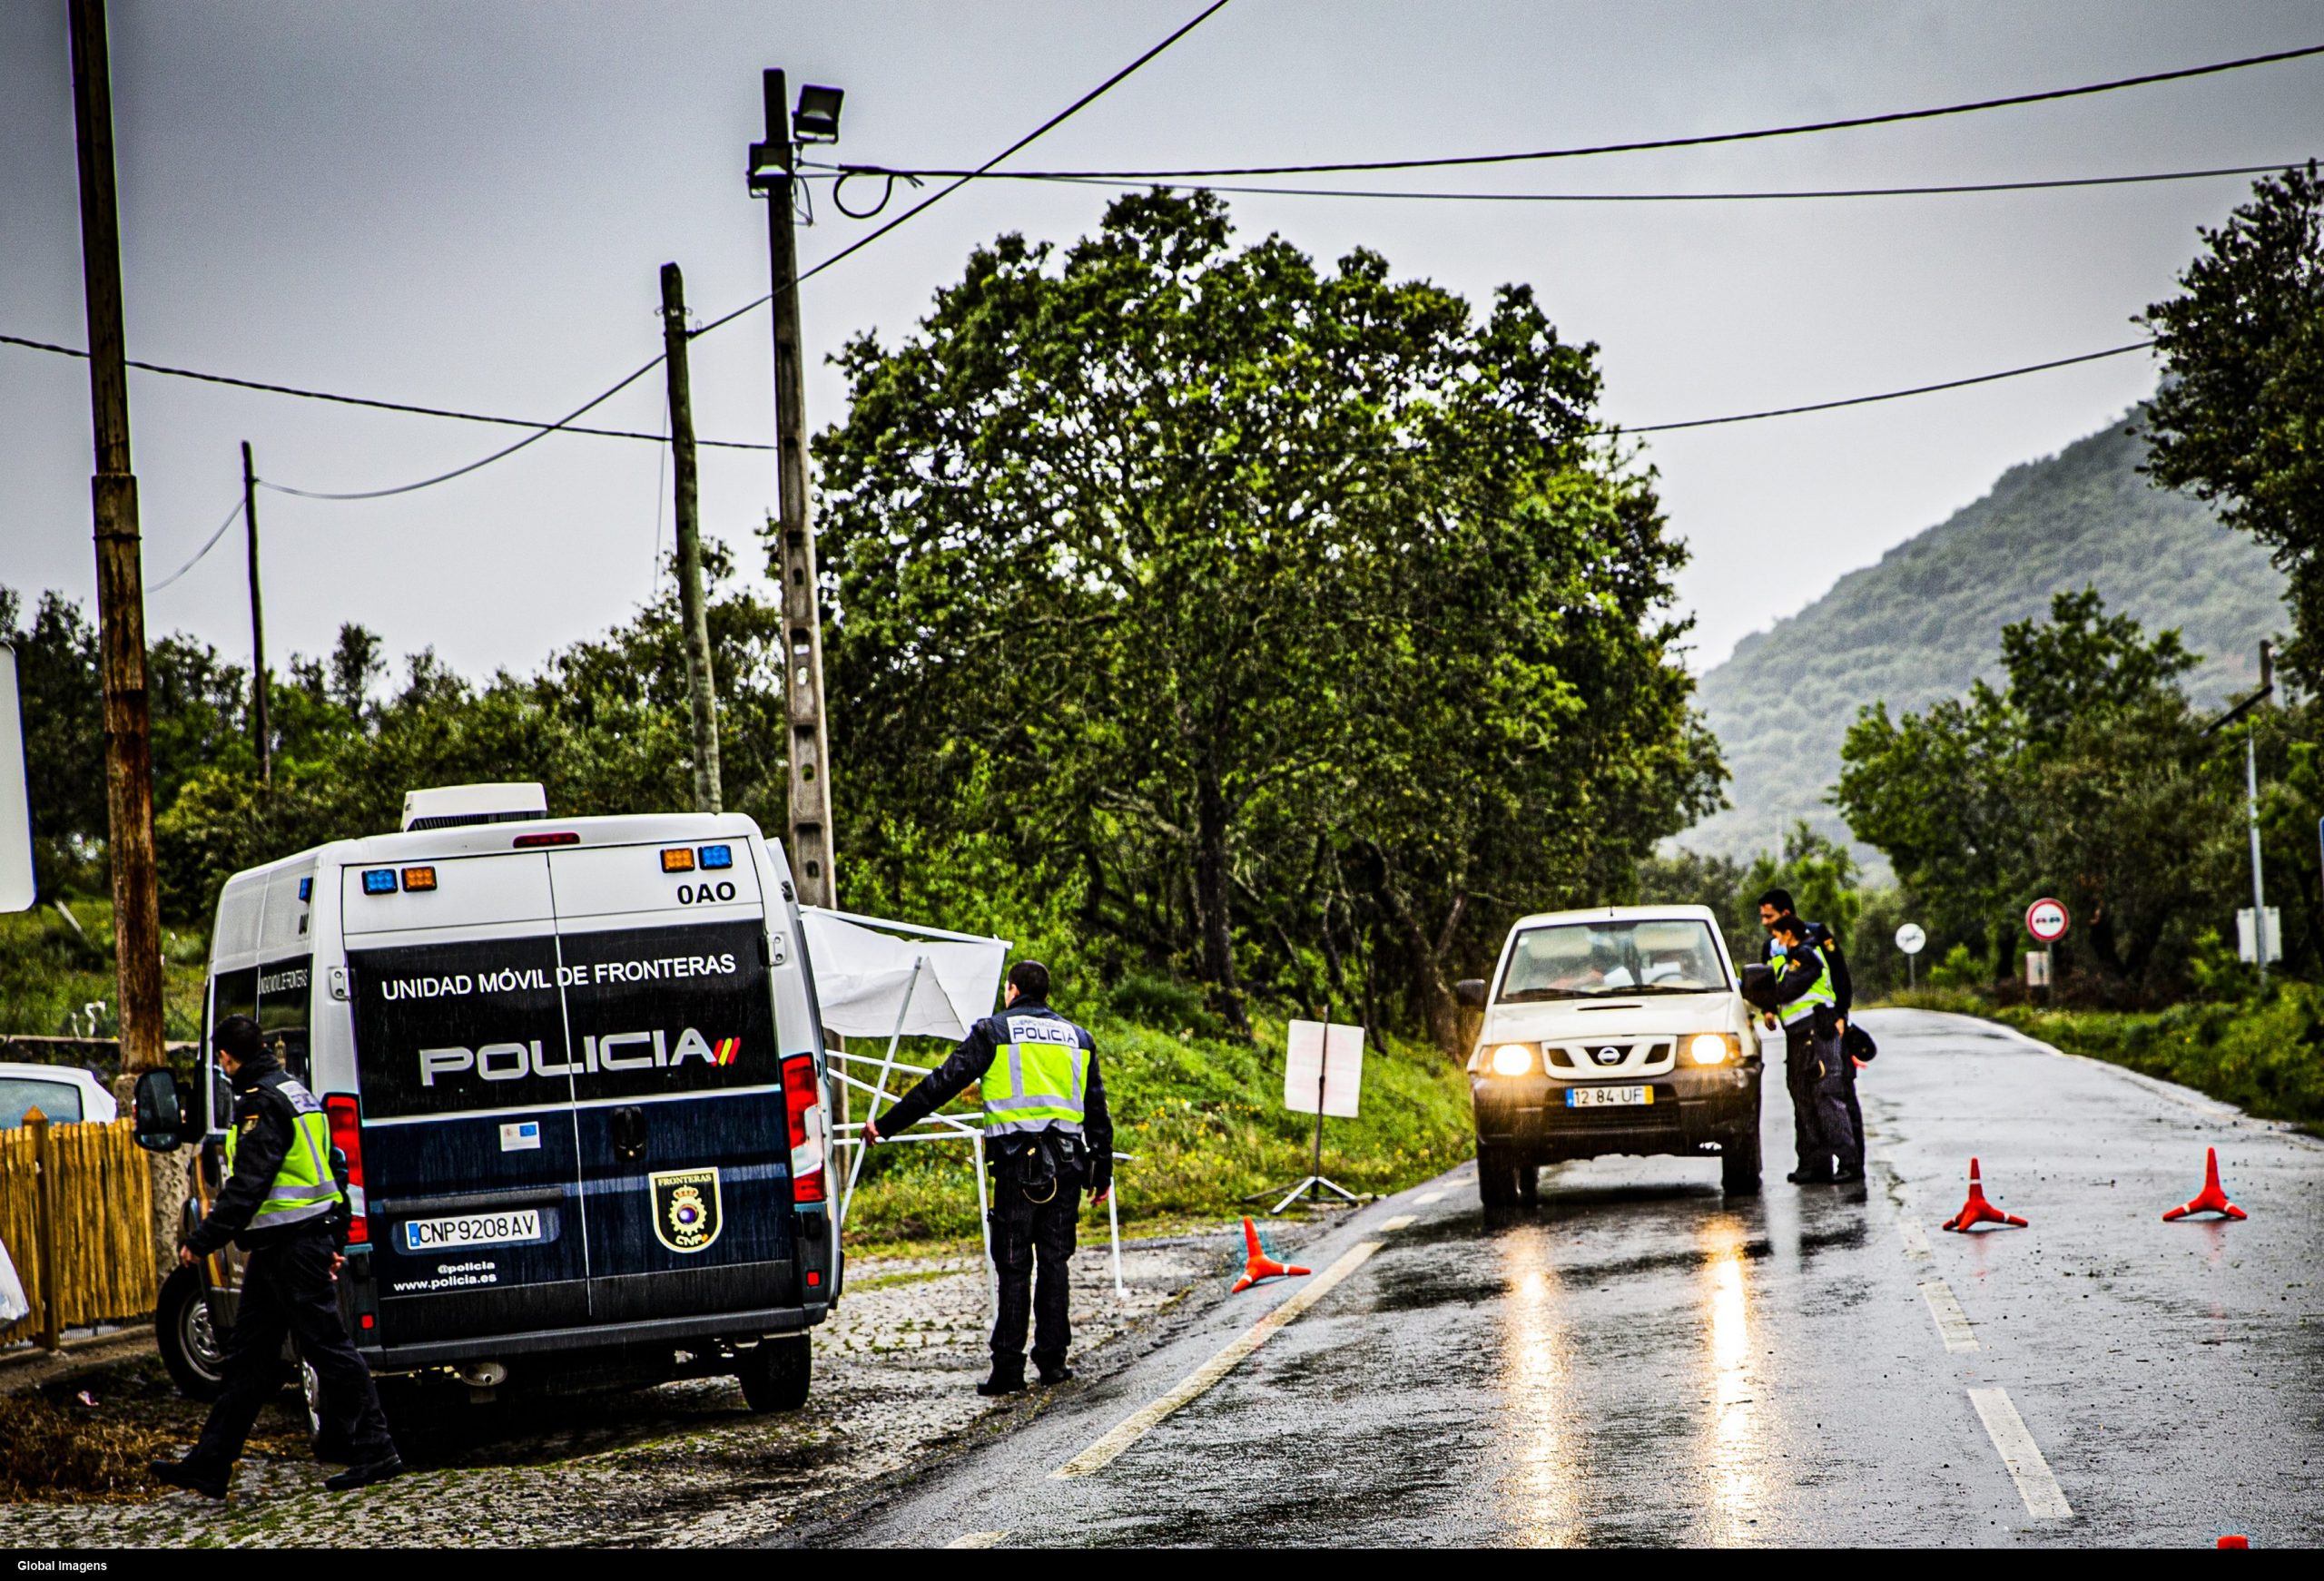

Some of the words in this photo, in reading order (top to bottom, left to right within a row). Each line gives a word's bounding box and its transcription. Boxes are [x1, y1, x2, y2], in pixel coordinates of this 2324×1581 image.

[381, 975, 472, 1000] UNIDAD
[478, 967, 552, 993] MÓVIL
[556, 966, 589, 987] DE
[594, 953, 736, 984] FRONTERAS
[1012, 1026, 1077, 1045] POLICIA
[419, 1027, 716, 1085] POLICIA
[657, 1173, 712, 1186] FRONTERAS
[675, 1234, 703, 1246] CNP
[437, 1261, 496, 1274] @policia
[393, 1272, 497, 1291] www.policia.es
